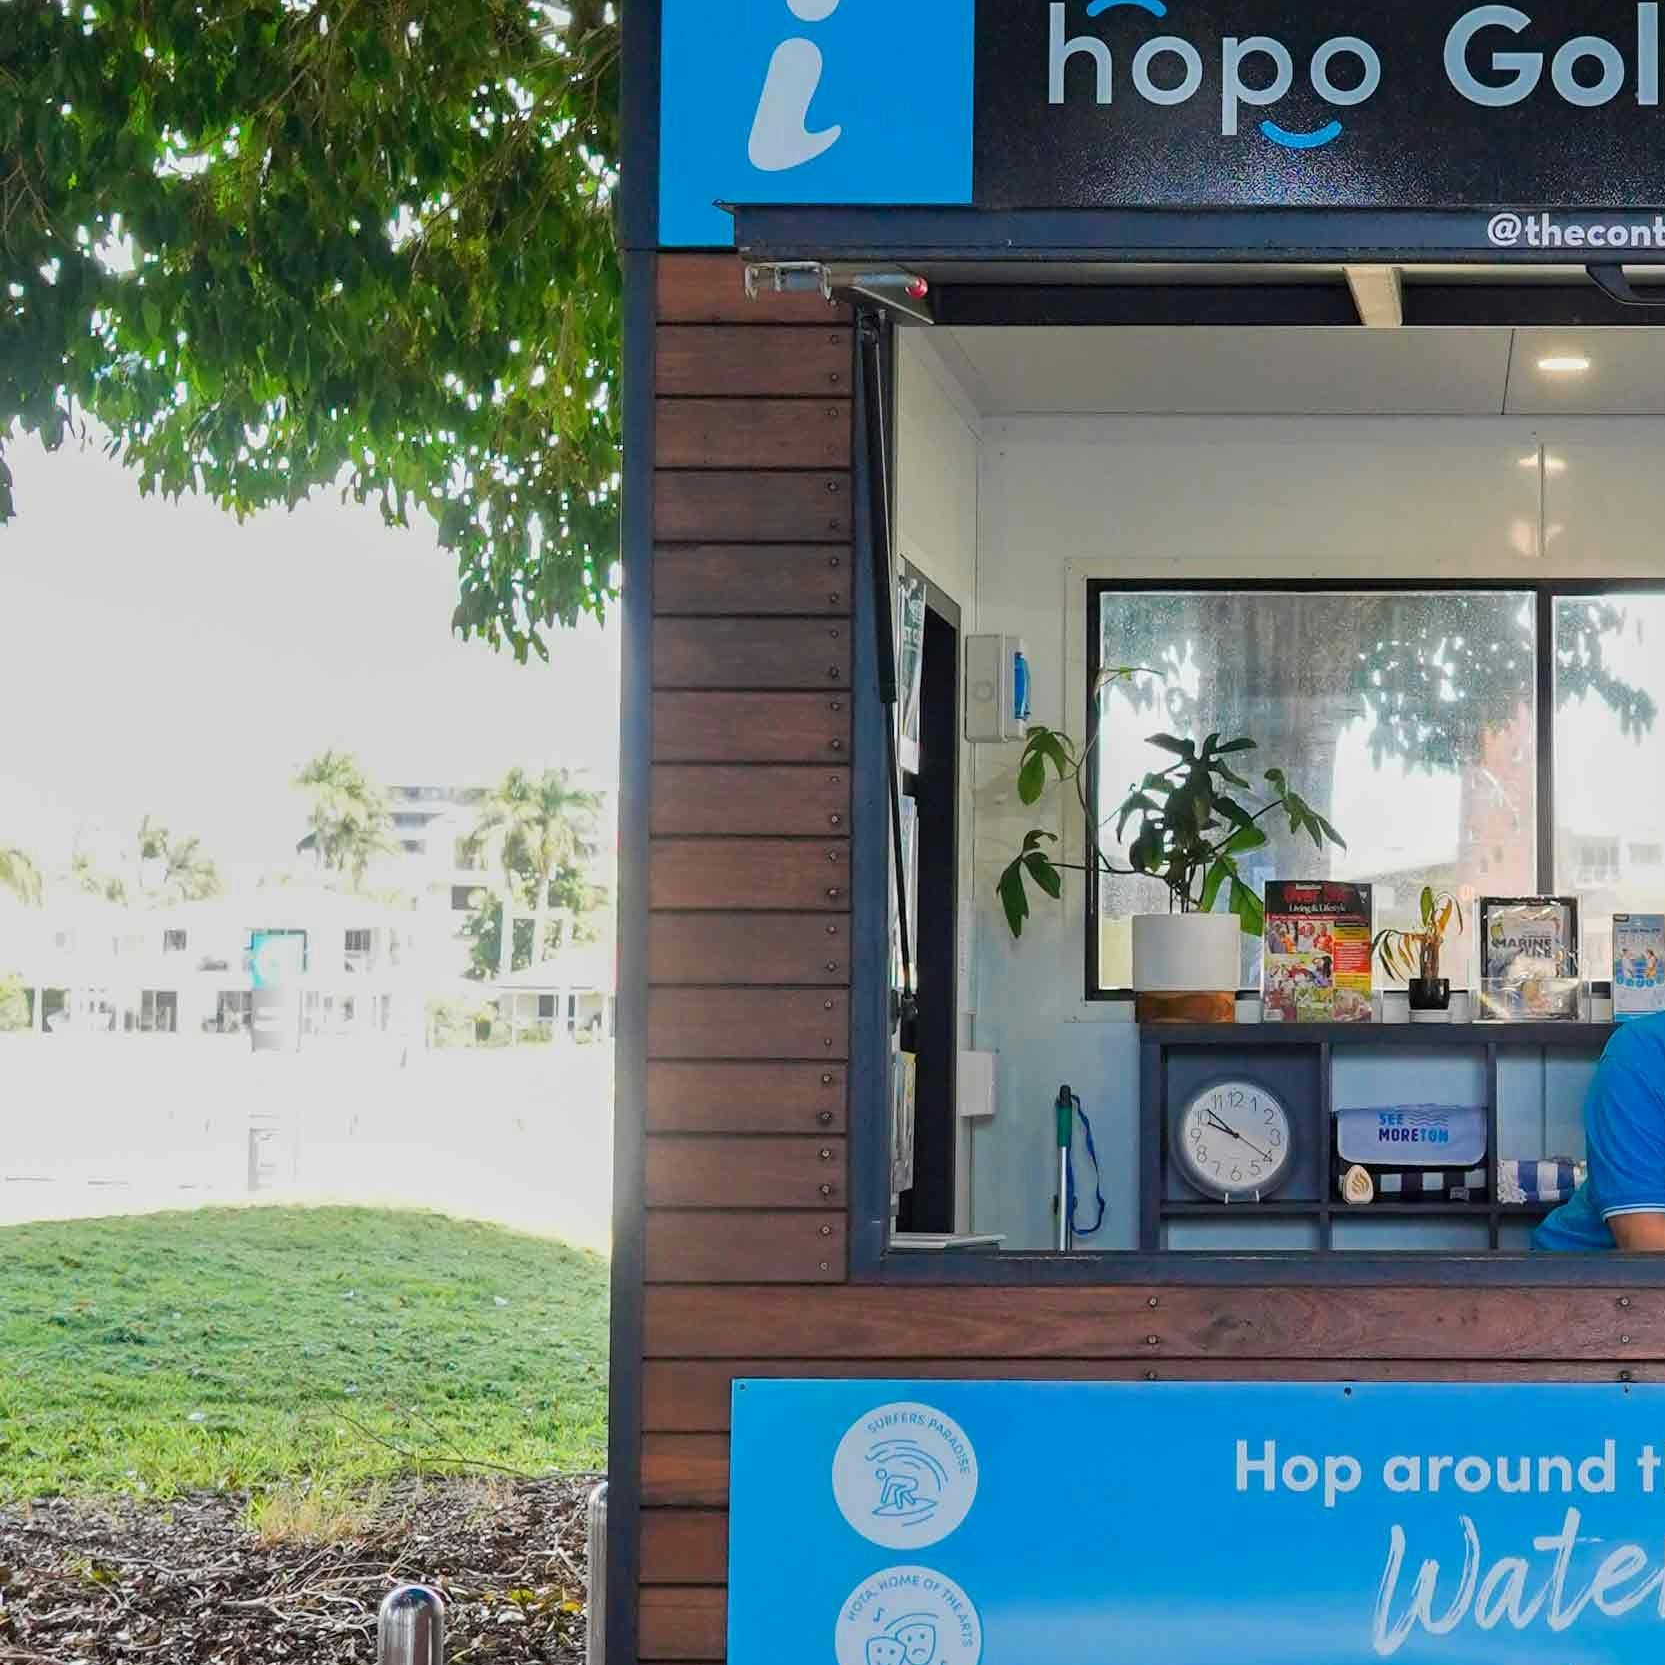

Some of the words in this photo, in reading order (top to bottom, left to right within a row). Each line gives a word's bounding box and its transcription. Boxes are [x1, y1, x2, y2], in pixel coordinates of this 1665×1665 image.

[1213, 1094, 1223, 1111] 11
[1228, 1091, 1244, 1108] 12
[1250, 1096, 1257, 1111] 1
[1263, 1108, 1275, 1125] 2
[1378, 1112, 1406, 1125] SEE
[1190, 1127, 1202, 1144] 9
[1269, 1128, 1281, 1146] 3
[1378, 1127, 1449, 1144] MORETON
[1196, 1145, 1208, 1163] 8
[1211, 1160, 1221, 1176] 7
[1230, 1167, 1242, 1182] 6
[1249, 1160, 1262, 1176] 5
[867, 1412, 927, 1433] SURFERS
[927, 1416, 971, 1477] PARADISE
[1236, 1439, 1362, 1508] Hop
[1383, 1439, 1616, 1495] around
[878, 1574, 921, 1591] HOME
[923, 1577, 940, 1592] OF
[942, 1588, 963, 1613] THE
[957, 1612, 974, 1648] ARTS
